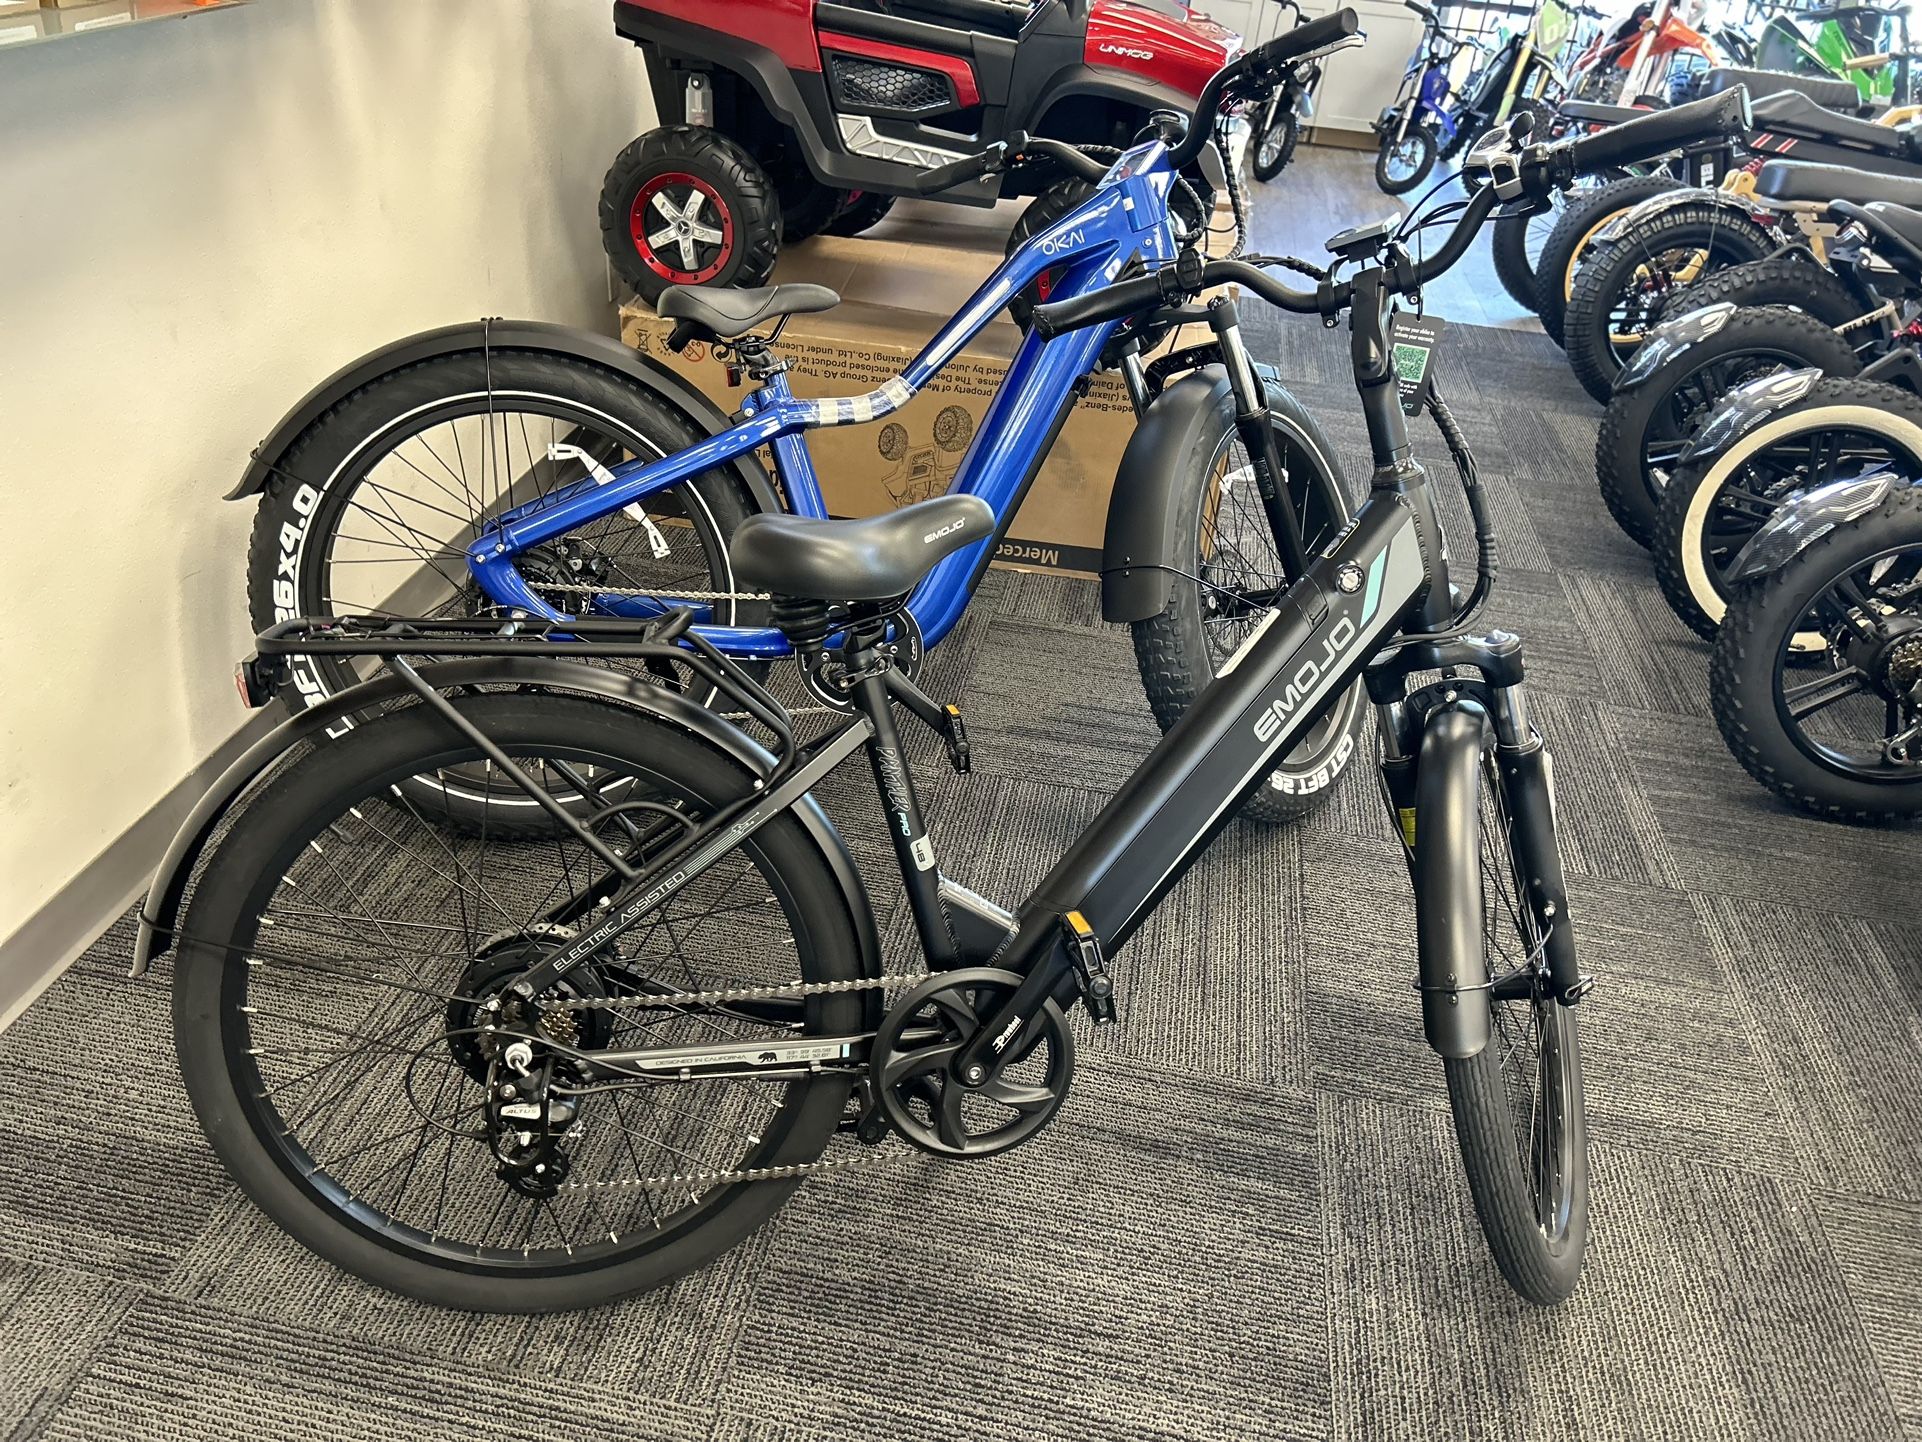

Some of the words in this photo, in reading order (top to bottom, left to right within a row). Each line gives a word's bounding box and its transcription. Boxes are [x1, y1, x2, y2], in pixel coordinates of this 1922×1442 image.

[806, 345, 832, 355] under
[811, 357, 846, 368] product
[849, 362, 890, 373] enclosed
[797, 364, 818, 376] They
[973, 365, 983, 375] by
[840, 371, 868, 382] Group
[954, 374, 972, 382] The
[941, 384, 951, 393] of
[954, 384, 992, 397] property
[924, 518, 965, 544] EMOJO
[1253, 616, 1356, 742] EMOJO
[1331, 733, 1354, 778] CST
[898, 812, 911, 837] PRO
[553, 921, 618, 971] ELECTRIC
[619, 871, 685, 923] ASSISTED
[655, 1058, 692, 1066] DESIGNED
[704, 1054, 747, 1062] CALIFORNIA
